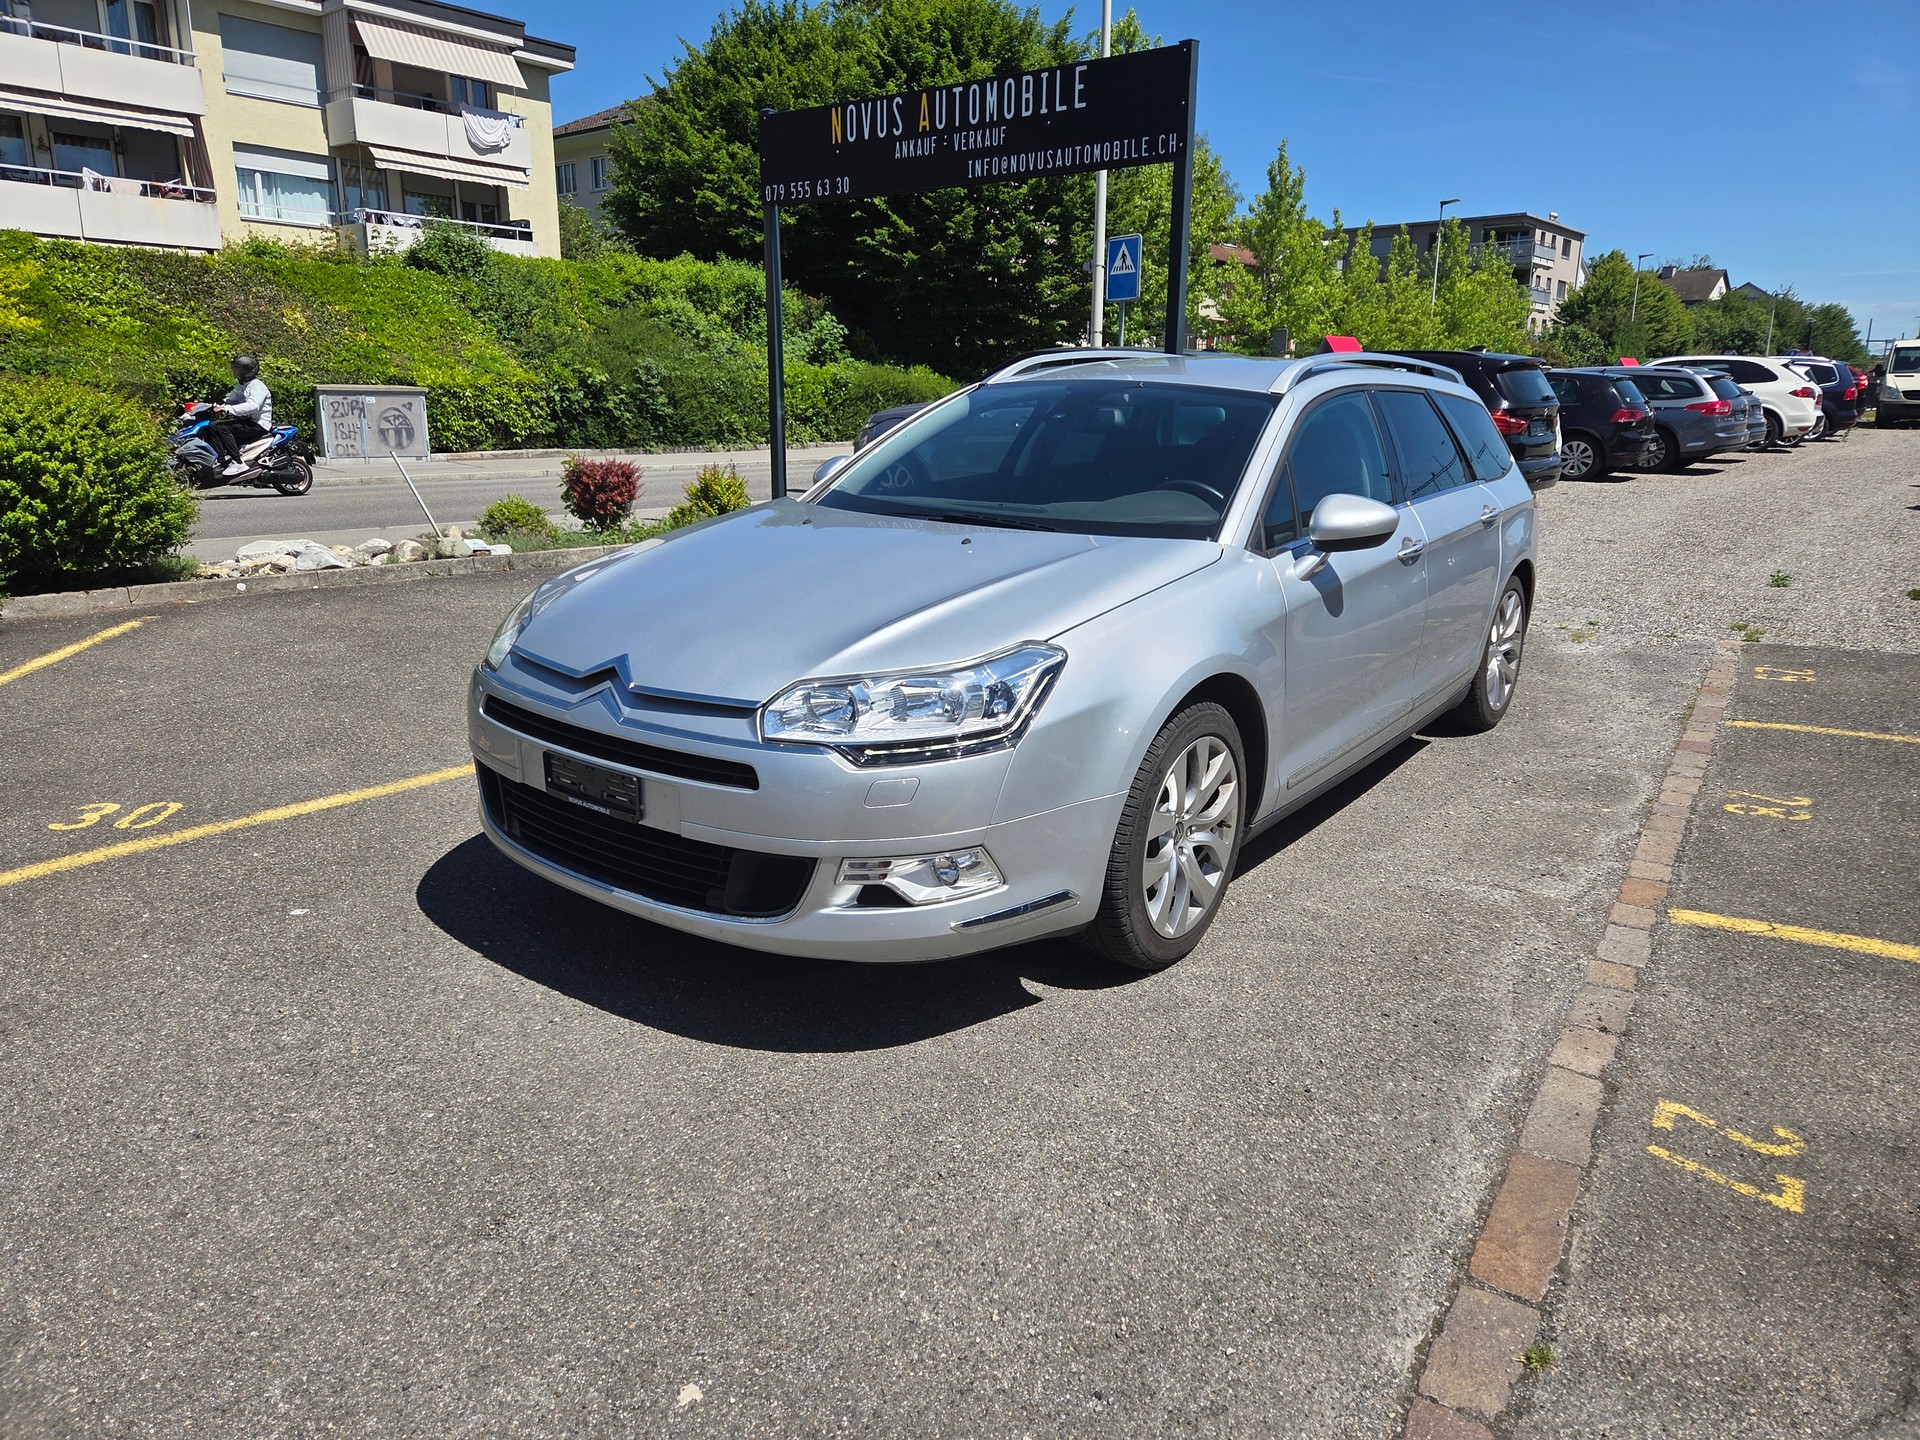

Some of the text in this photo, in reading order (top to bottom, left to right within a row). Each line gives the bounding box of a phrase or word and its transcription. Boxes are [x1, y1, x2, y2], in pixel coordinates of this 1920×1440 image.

[831, 64, 1088, 145] NOVUS AUTOMOBILE
[894, 136, 938, 160] ANKAUF
[953, 126, 1007, 152] VERKAUF
[967, 132, 1178, 179] INFO@NOVUSAUTOMOBILE.CH
[765, 176, 850, 202] 079 555 63 30
[47, 802, 184, 831] 30
[568, 796, 611, 815] NOVUS AUTOMOBILE
